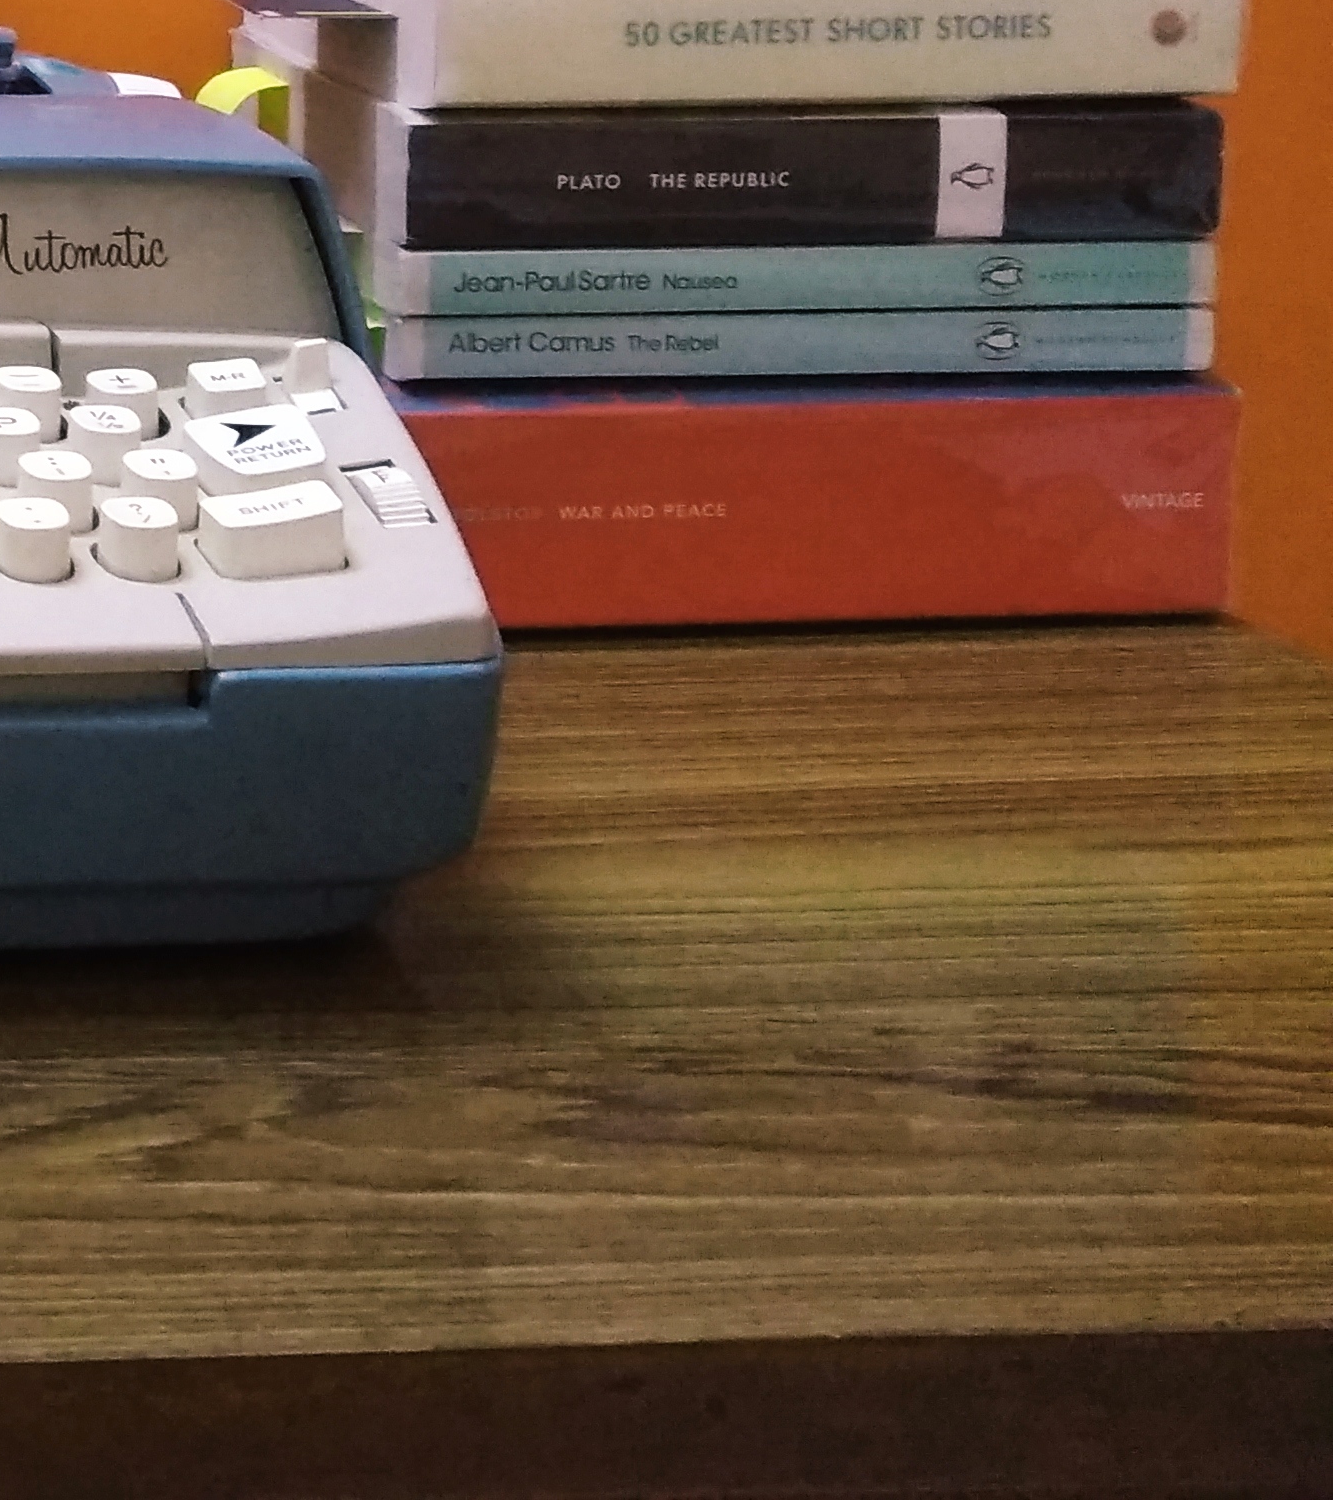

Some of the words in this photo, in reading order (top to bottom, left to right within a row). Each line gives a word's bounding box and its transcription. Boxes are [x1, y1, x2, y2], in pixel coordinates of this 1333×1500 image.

[625, 21, 660, 47] 50
[669, 17, 815, 45] GREATEST
[827, 16, 925, 43] SHORT
[936, 13, 1052, 41] STORIES
[557, 174, 622, 190] PLATO
[649, 173, 687, 188] THE
[694, 171, 790, 188] REPUBLIC
[580, 271, 651, 291] Sartre
[663, 273, 738, 289] Nausea
[449, 333, 520, 353] Albert
[529, 332, 615, 353] Camus
[628, 335, 661, 351] The
[665, 335, 719, 351] Rebel
[226, 438, 304, 456] POWER
[234, 446, 312, 465] RETURN
[237, 497, 305, 515] SHIFT
[1121, 492, 1204, 508] VINTAGE
[559, 505, 602, 519] WAR
[612, 504, 655, 518] AND
[663, 503, 727, 518] PEACE
